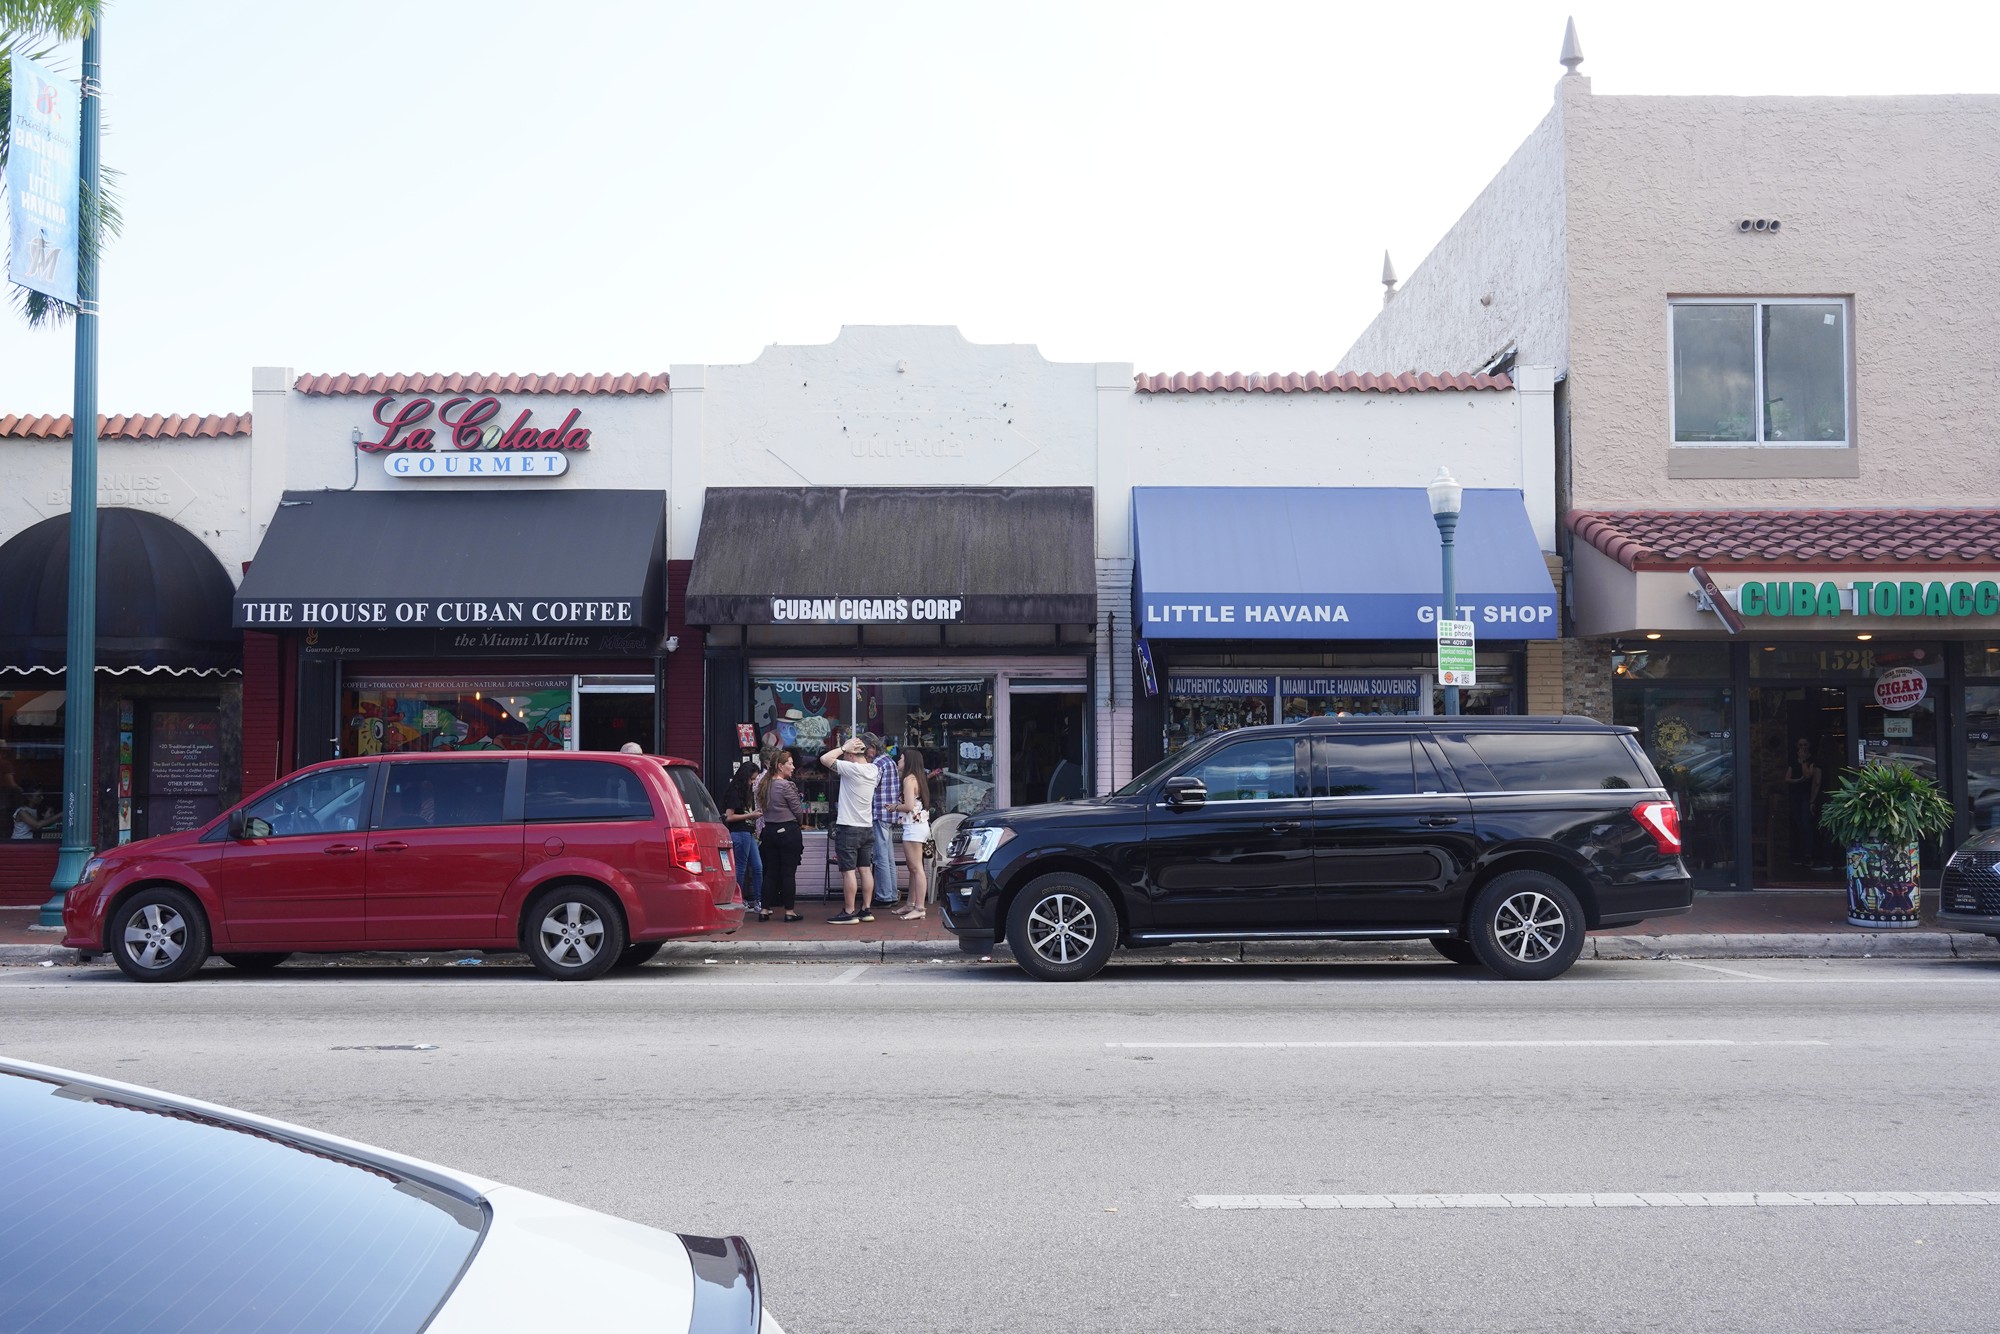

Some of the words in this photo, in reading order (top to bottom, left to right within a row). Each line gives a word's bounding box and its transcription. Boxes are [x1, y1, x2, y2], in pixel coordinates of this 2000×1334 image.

[21, 190, 66, 226] HAVANA
[358, 397, 435, 454] La
[394, 456, 558, 473] GOURMET
[1741, 581, 1841, 617] CUBA
[242, 604, 293, 623] THE
[301, 603, 387, 622] HOUSE
[395, 603, 428, 622] OF
[437, 602, 523, 622] CUBAN
[531, 602, 632, 621] COFFEE
[773, 599, 836, 620] CUBAN
[839, 599, 908, 620] CIGARS
[911, 599, 962, 620] CORP
[1147, 605, 1235, 623] LITTLE
[1245, 605, 1349, 623] HAVANA
[1417, 605, 1475, 623] GIT
[1484, 605, 1553, 623] SHOP
[455, 633, 477, 647] the
[479, 632, 529, 647] Miami
[532, 632, 590, 647] Marlins
[306, 645, 333, 653] Gourmet
[334, 645, 360, 655] Espresso
[1818, 649, 1875, 671] 1528
[371, 681, 406, 689] TOBACCO
[427, 681, 469, 689] CHOCOLATE
[775, 681, 850, 693] SOUVENIRS
[1176, 679, 1220, 694] AUTHENTIC
[1222, 679, 1268, 694] SOUVENIRS
[1282, 679, 1307, 694] MIAMI
[1308, 679, 1336, 694] LITTLE
[1337, 679, 1370, 694] HAVANA
[1371, 679, 1417, 695] SOUVENIRS
[1877, 678, 1924, 697] CIGAR
[1882, 693, 1920, 705] FACTORY
[939, 712, 962, 720] CUBAN
[962, 712, 982, 720] CIGAR
